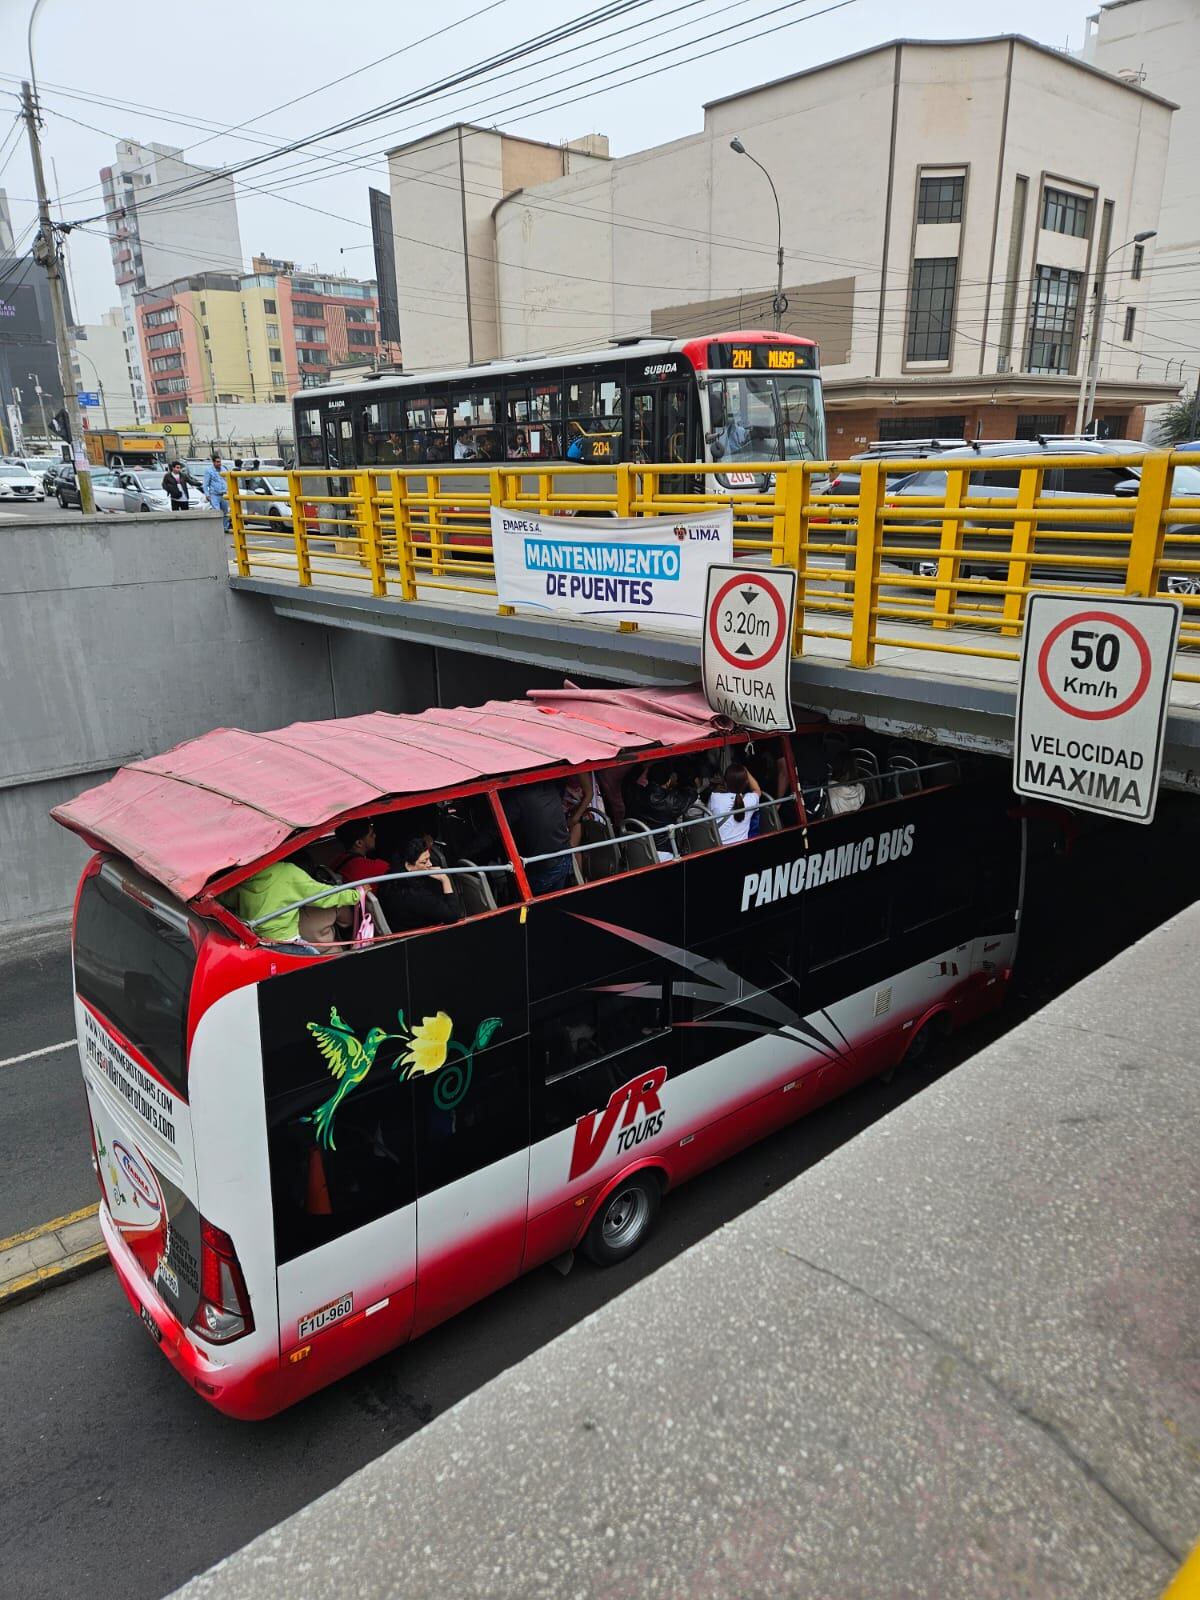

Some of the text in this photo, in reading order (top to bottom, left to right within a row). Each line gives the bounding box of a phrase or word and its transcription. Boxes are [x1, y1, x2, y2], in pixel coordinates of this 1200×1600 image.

[644, 363, 677, 376] SUBIDA
[733, 350, 752, 369] 204
[592, 441, 610, 456] 204
[503, 520, 528, 531] EMAPE
[689, 529, 720, 541] LIMA
[526, 543, 679, 576] MANTENIMIENTO
[546, 573, 653, 605] DE PUENTES
[724, 610, 770, 638] 3.20m
[1070, 630, 1120, 673] 50
[716, 673, 775, 701] ALTURA
[1063, 676, 1118, 699] Km/h
[717, 697, 778, 725] MAXIMA
[1031, 734, 1144, 771] VELOCIDAD
[1024, 759, 1142, 808] MAXIMA
[876, 824, 916, 866] BUS
[568, 1066, 667, 1182] VR
[617, 1110, 666, 1154] TOURS
[301, 1300, 351, 1337] F1U-960
